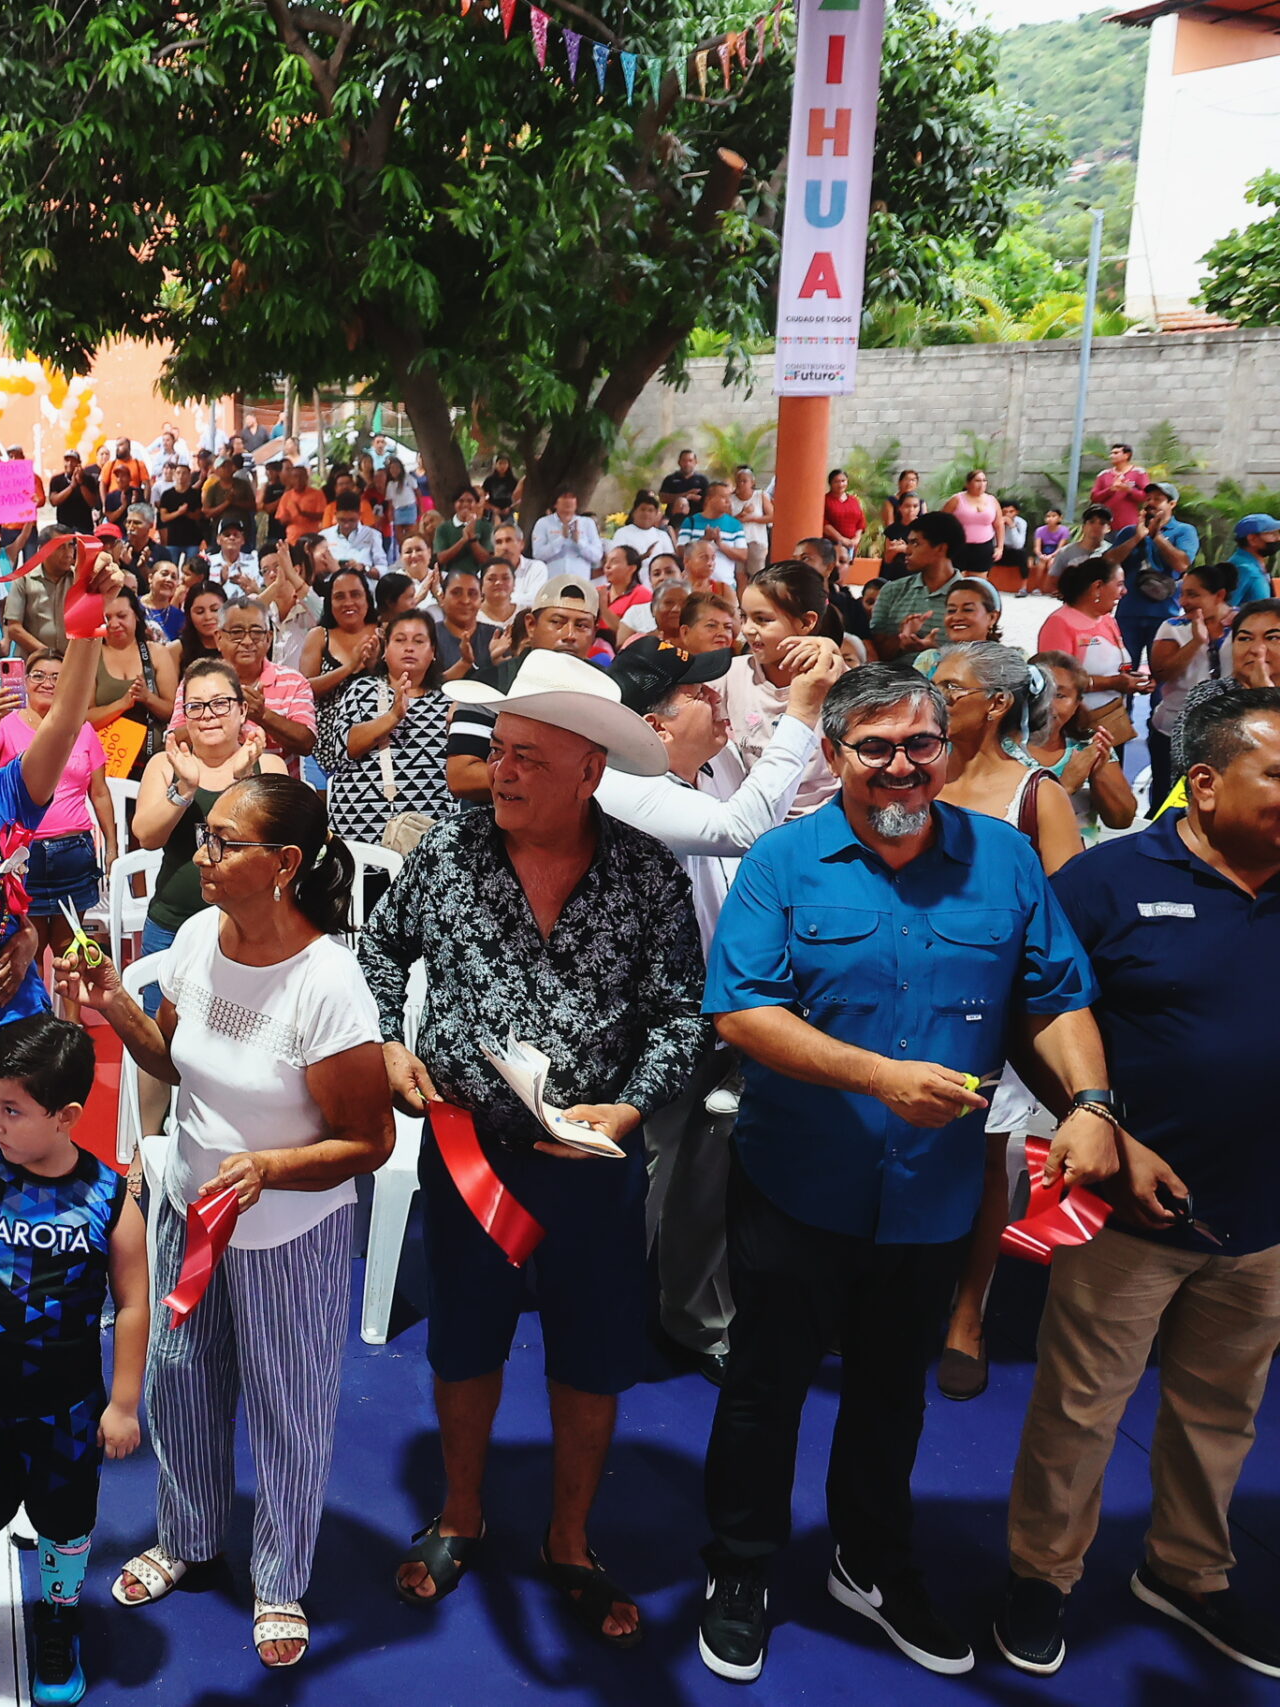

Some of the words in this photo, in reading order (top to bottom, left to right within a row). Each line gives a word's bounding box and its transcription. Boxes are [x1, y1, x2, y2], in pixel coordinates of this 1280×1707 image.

[798, 0, 860, 299] IHUA
[826, 315, 853, 323] TODOS
[794, 370, 836, 380] Futuro
